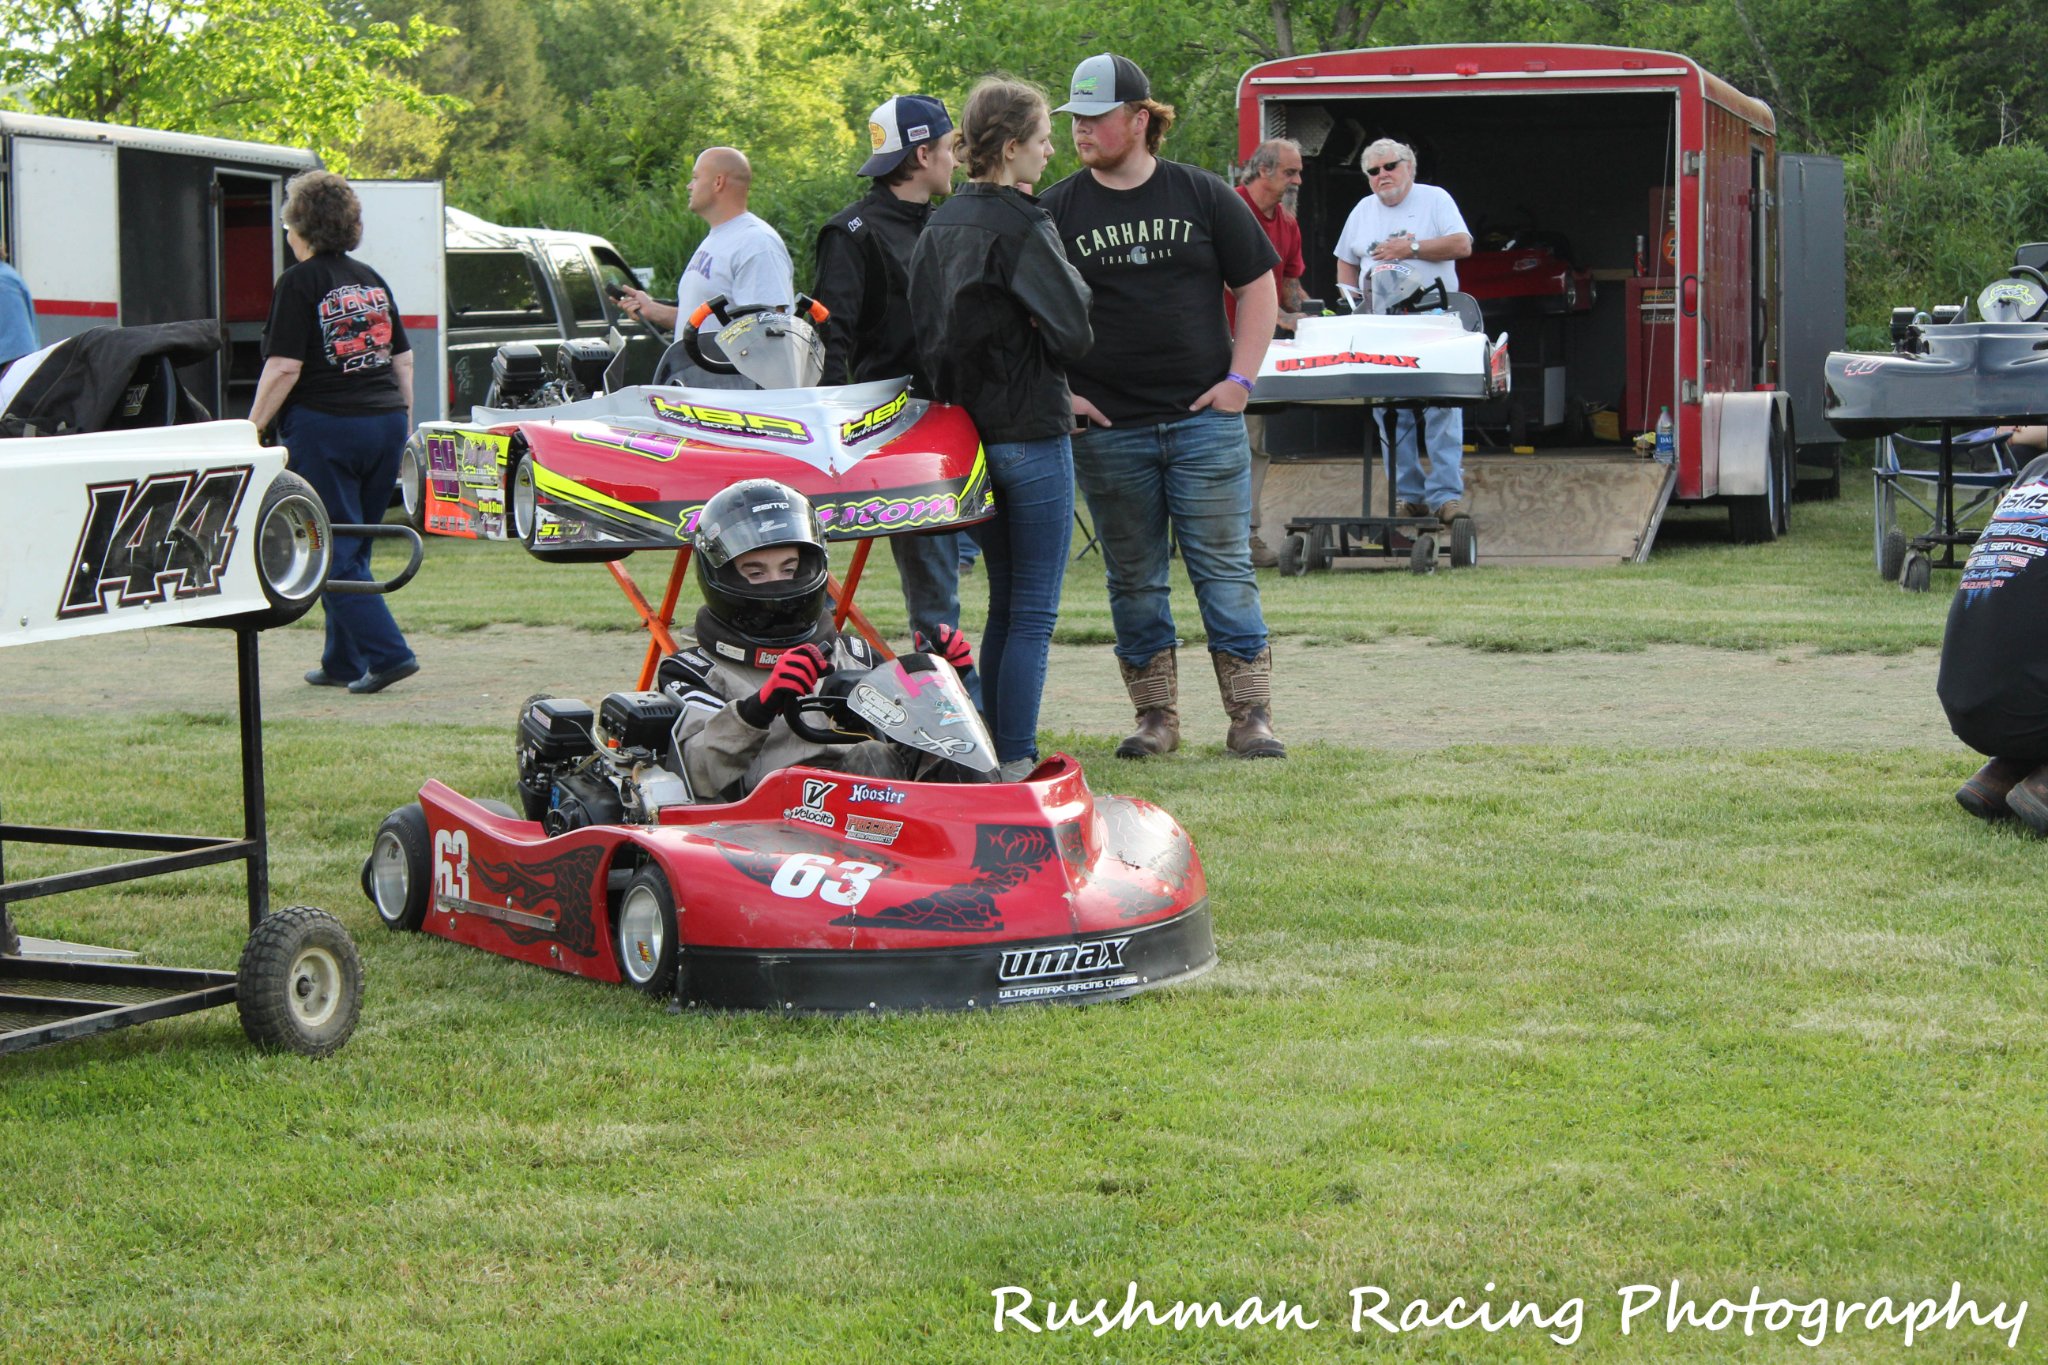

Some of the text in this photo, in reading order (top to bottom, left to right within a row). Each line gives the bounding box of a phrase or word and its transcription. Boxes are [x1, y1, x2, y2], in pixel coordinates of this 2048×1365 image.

[1075, 218, 1194, 258] CARHARTT
[1101, 248, 1172, 265] TRADEMARK
[1275, 351, 1420, 373] ULTRAMAX
[654, 397, 808, 435] HBR
[745, 427, 809, 441] RACING
[752, 502, 790, 513] zamp
[56, 463, 255, 621] 144
[1989, 541, 2047, 557] SERVICES
[849, 784, 905, 804] Hoosier
[847, 815, 901, 836] PRECISE
[434, 829, 470, 914] 63
[770, 853, 883, 906] 63
[999, 975, 1139, 999] ULTRAMAX RACING CHASSIS
